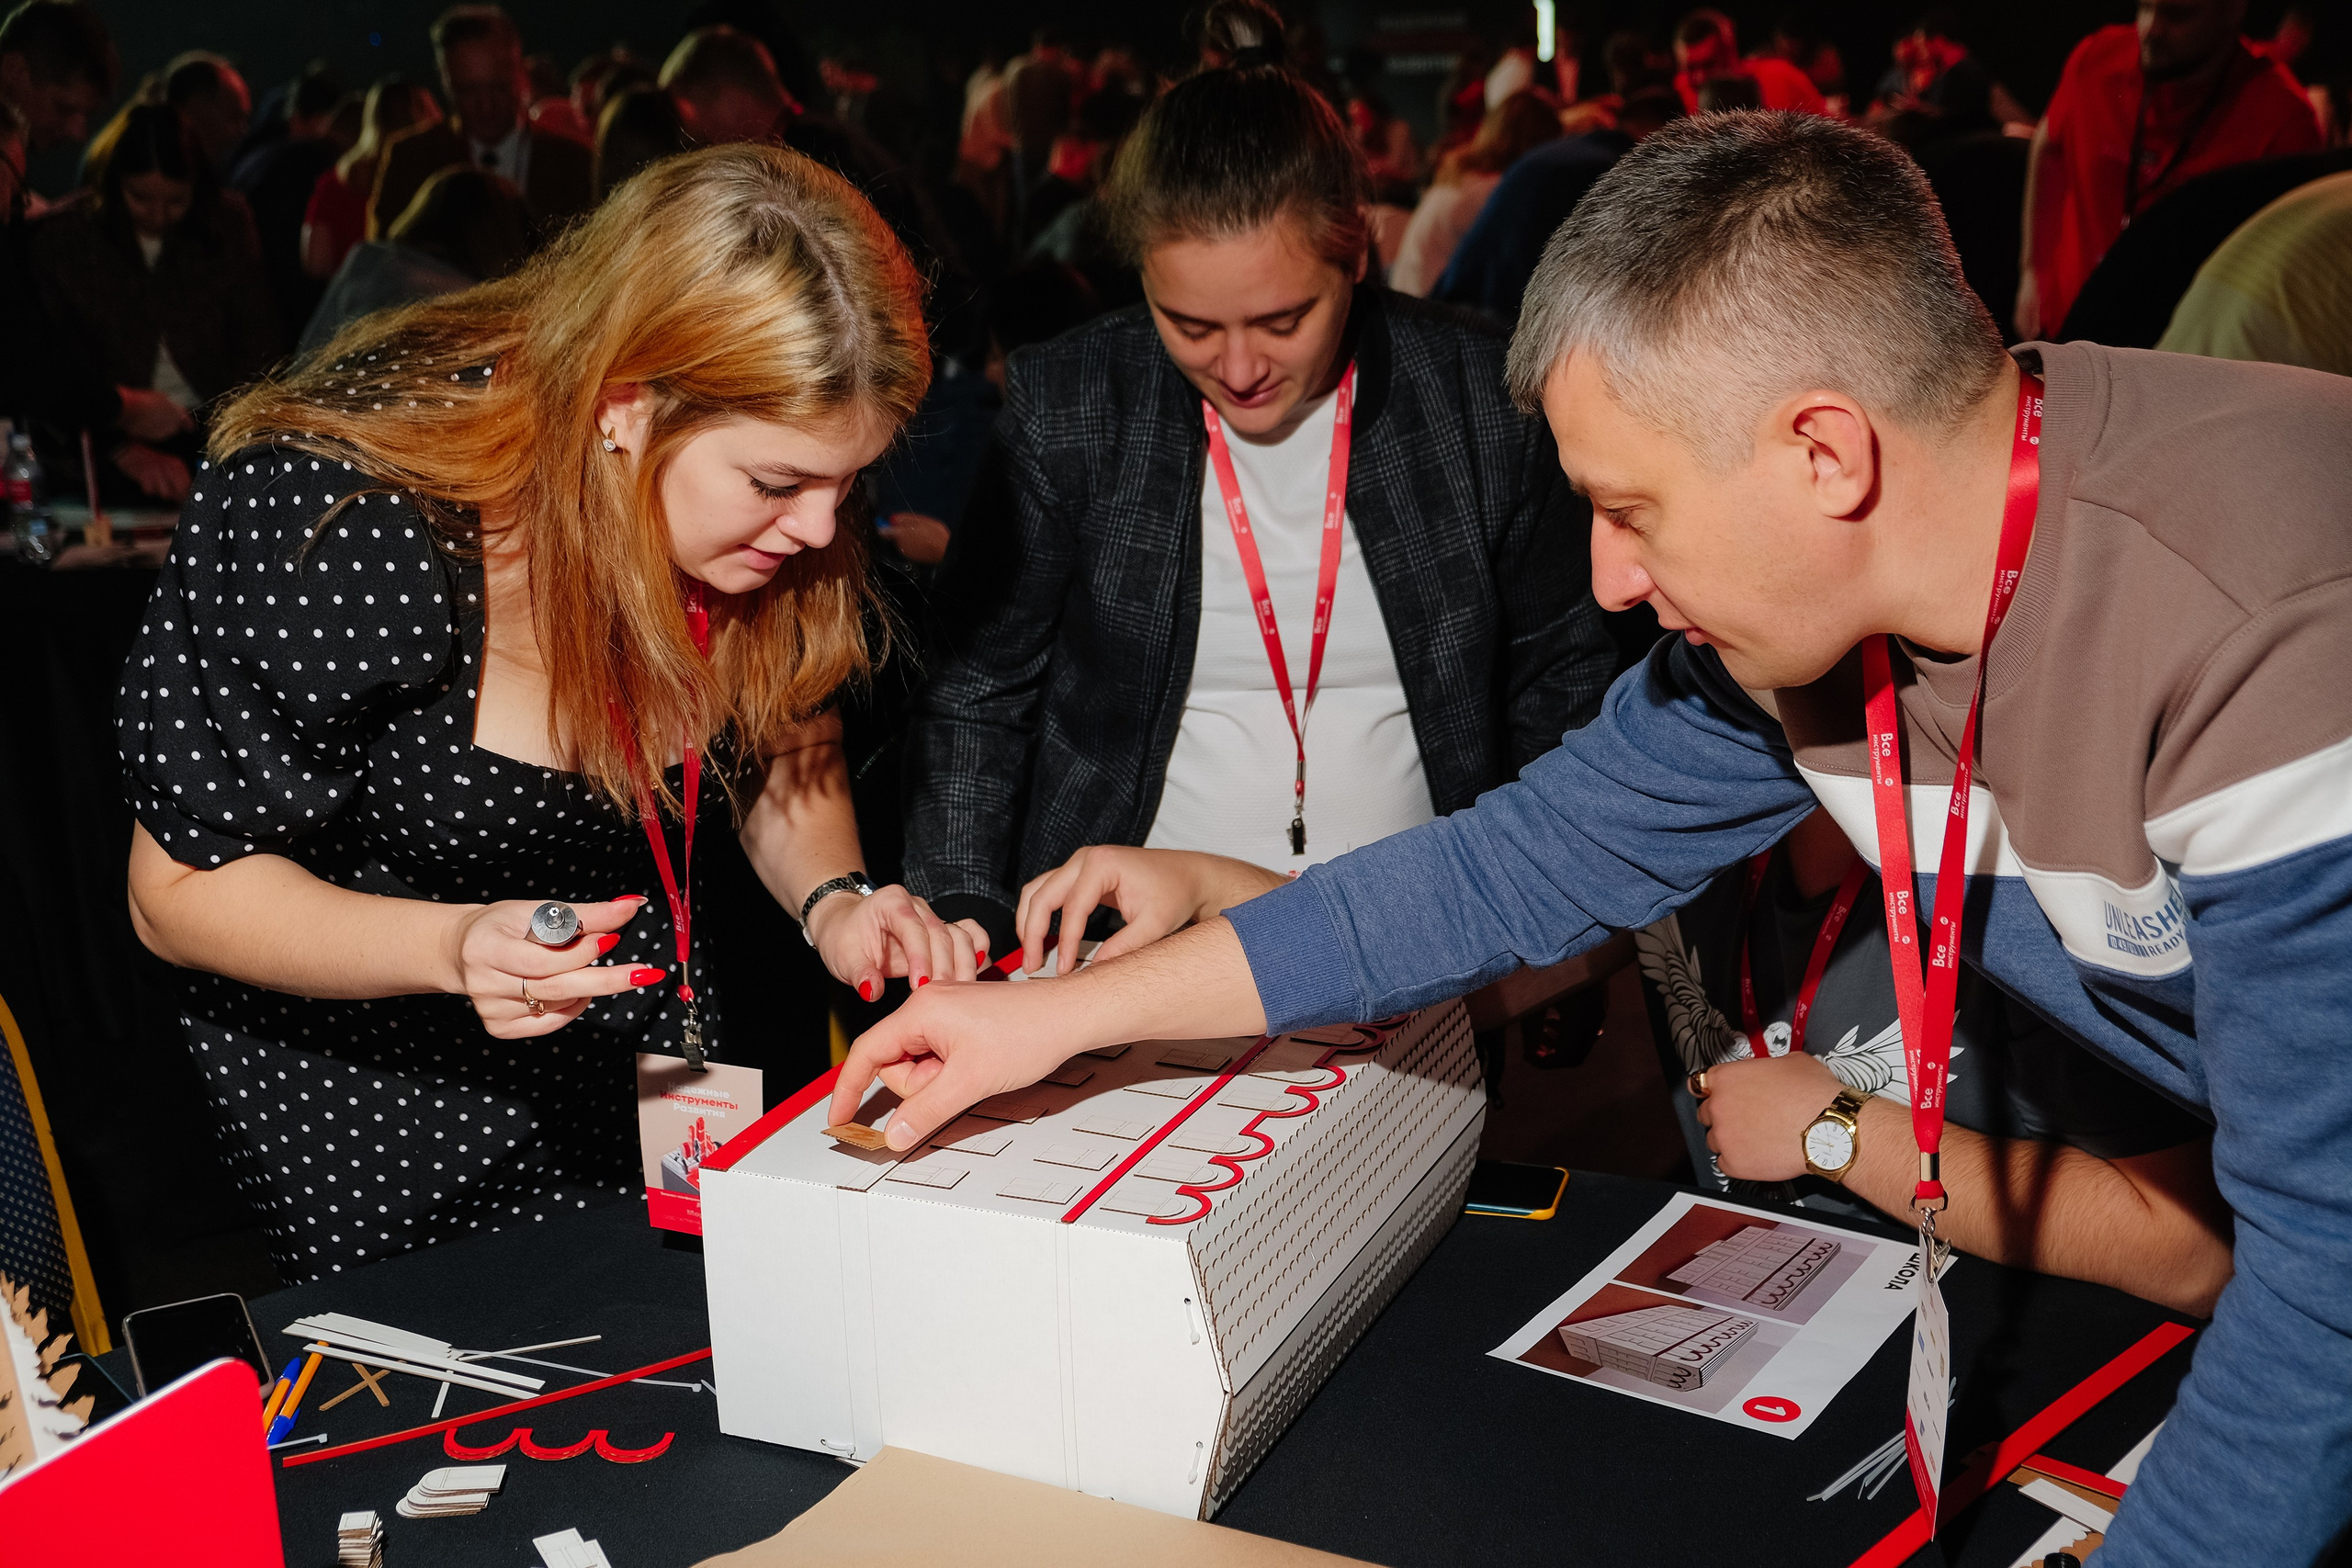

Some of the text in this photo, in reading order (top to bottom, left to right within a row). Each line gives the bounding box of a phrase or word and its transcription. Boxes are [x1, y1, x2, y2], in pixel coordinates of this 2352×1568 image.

[2003, 570, 2018, 594] Все
[1881, 732, 1894, 757] Все
[1872, 734, 1883, 785] инструменты
[1951, 791, 1962, 817] Все
[1896, 890, 1909, 915] Все
[1889, 892, 1899, 943] инструменты
[1932, 944, 1947, 967] Все
[1947, 921, 1957, 969] инструменты
[2147, 929, 2185, 957] READY
[1920, 1088, 1934, 1110] Все
[1934, 1064, 1944, 1109] инструменты
[660, 1090, 739, 1110] Инструменты
[673, 1102, 726, 1118] Развития
[1753, 1404, 1787, 1416] 1
